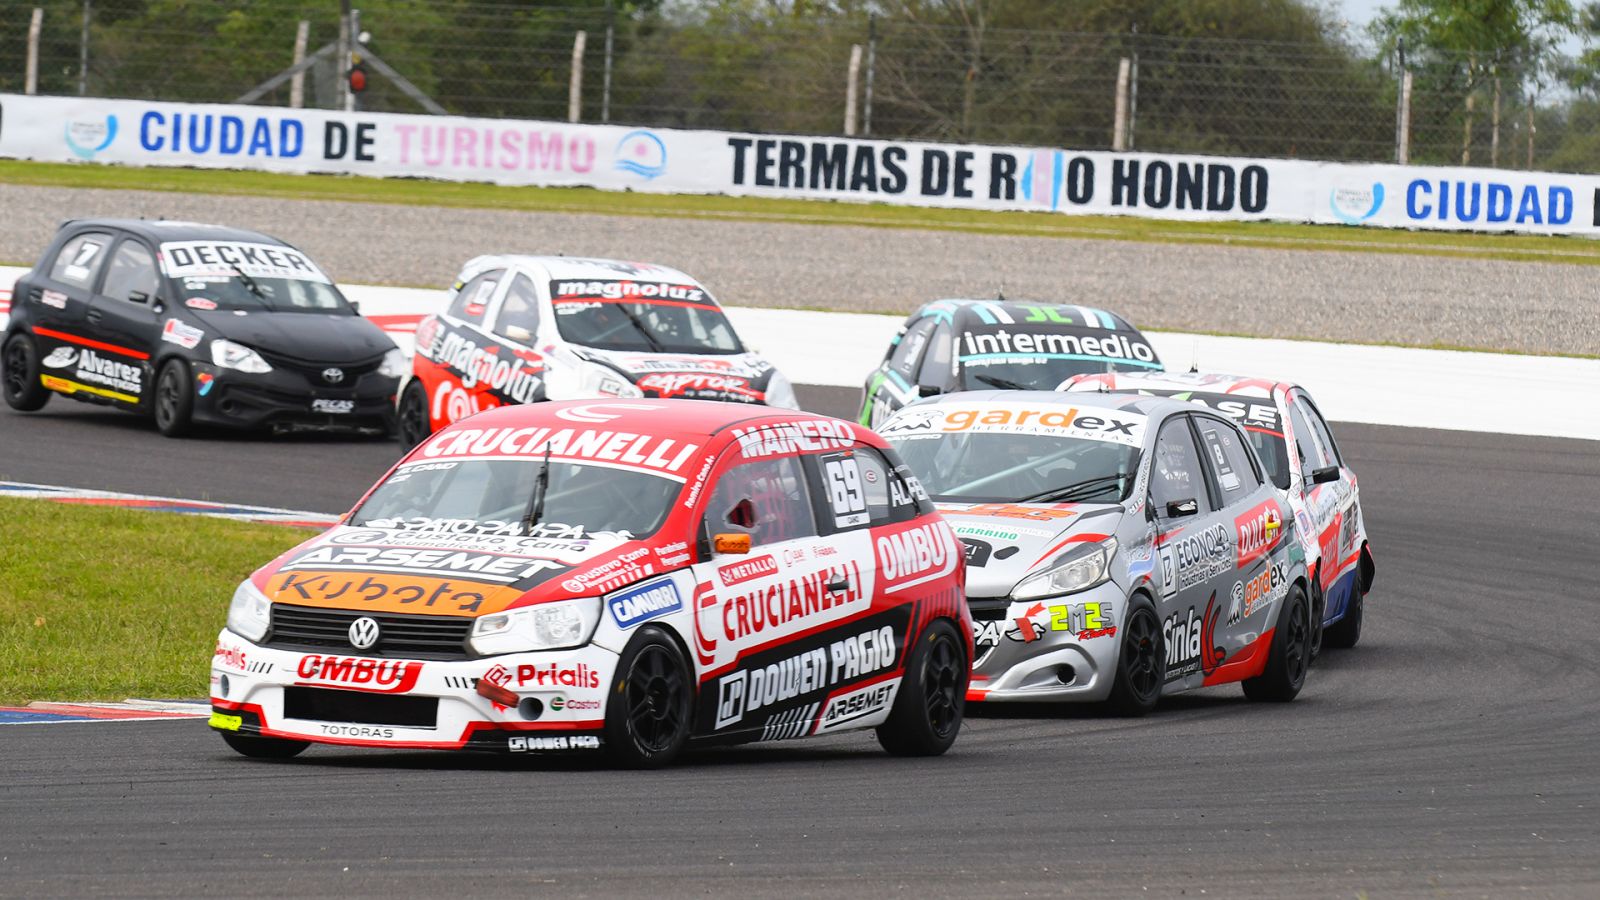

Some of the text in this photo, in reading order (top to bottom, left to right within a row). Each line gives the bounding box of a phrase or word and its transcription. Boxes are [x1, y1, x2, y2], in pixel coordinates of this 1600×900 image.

[140, 111, 301, 157] CIUDAD
[323, 121, 376, 162] DE
[394, 124, 595, 173] TURISMO
[728, 138, 907, 195] TERMAS
[921, 149, 974, 199] DE
[1111, 158, 1270, 213] HONDO
[1406, 179, 1574, 225] CIUDAD
[73, 242, 101, 266] 7
[169, 245, 314, 272] DECKER
[557, 281, 704, 301] magnoluz
[964, 330, 1154, 362] intermedio
[78, 349, 141, 383] Alvarez
[439, 332, 542, 404] magnoluz
[731, 420, 856, 459] MAINERO
[942, 408, 1138, 437] gardex
[423, 427, 699, 471] CRUCIANELLI
[825, 459, 866, 514] 69
[393, 530, 586, 552] Gustavo Cano
[877, 521, 952, 581] OMBU
[291, 546, 566, 579] ARSEMET
[574, 559, 622, 582] Gustavo
[280, 574, 485, 613] Kubota
[612, 584, 680, 623] CAMURRI
[722, 559, 863, 642] CRUCIANELLI
[1244, 559, 1287, 618] gardex
[297, 654, 416, 686] OMBU
[517, 663, 599, 689] Prialis
[747, 625, 896, 711] DOWEN PAGIO
[566, 699, 600, 710] Castrol
[824, 684, 894, 721] ARSEMET
[320, 724, 394, 738] TOTORAS
